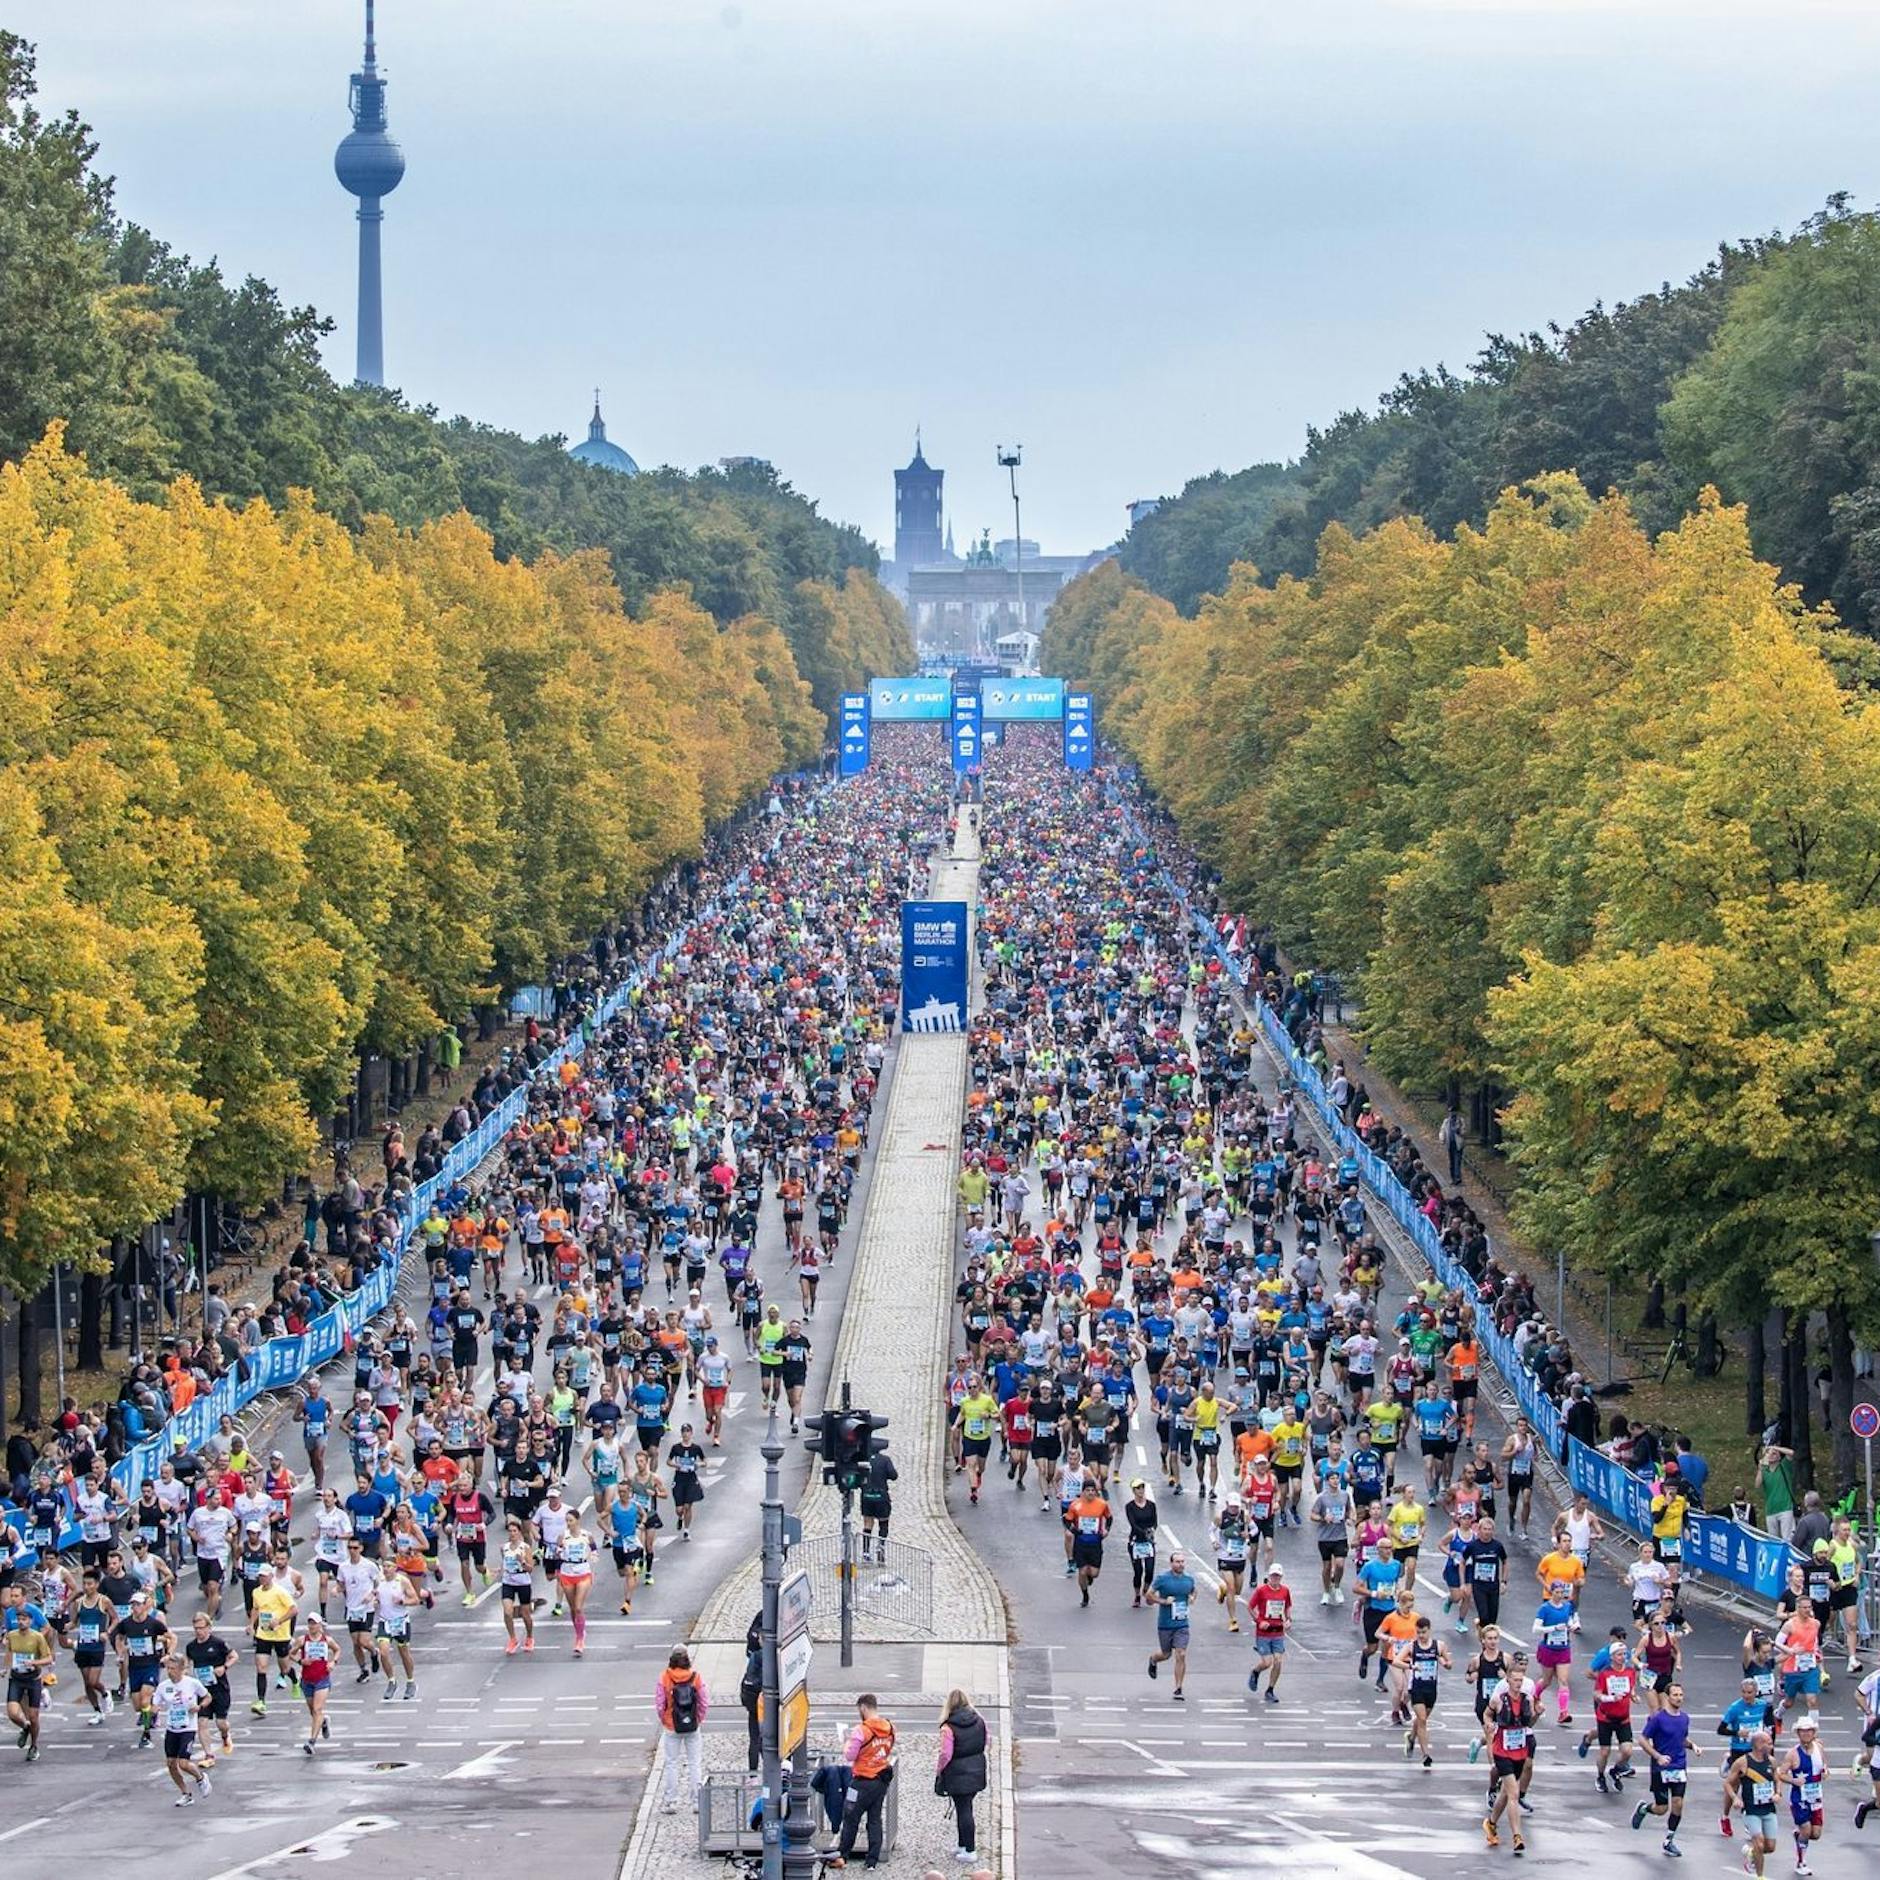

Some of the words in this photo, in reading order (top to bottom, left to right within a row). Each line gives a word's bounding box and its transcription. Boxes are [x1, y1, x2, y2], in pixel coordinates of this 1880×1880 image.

[914, 693, 944, 702] START
[1026, 693, 1056, 702] START
[914, 922, 940, 931] BMW
